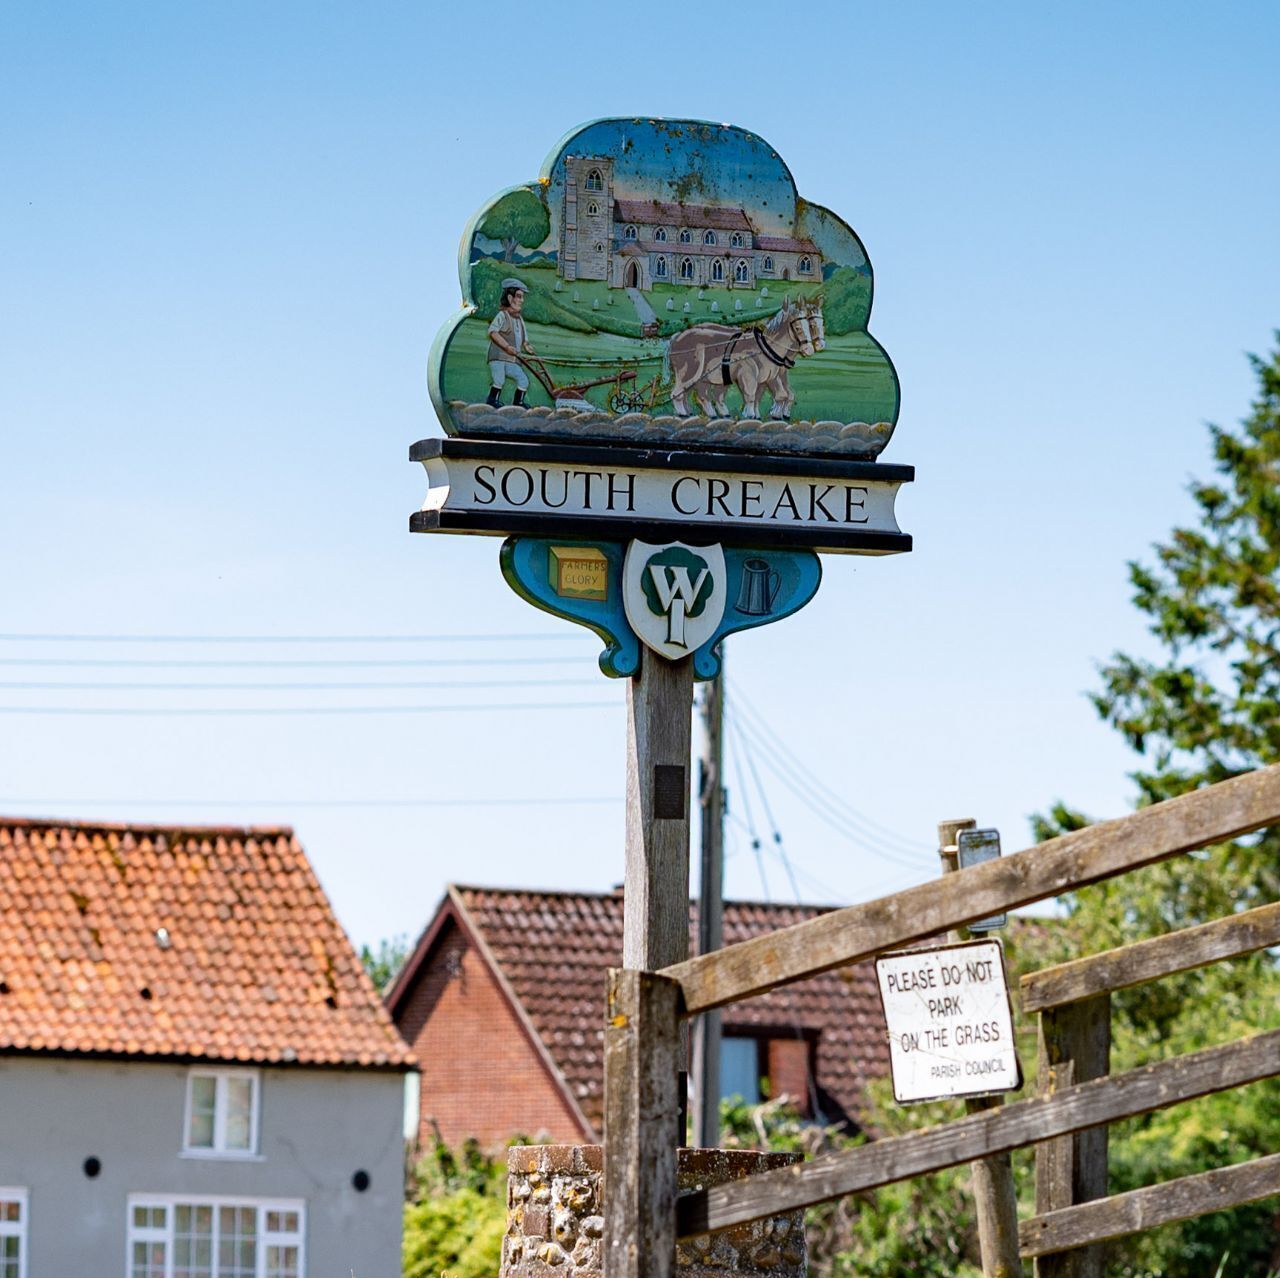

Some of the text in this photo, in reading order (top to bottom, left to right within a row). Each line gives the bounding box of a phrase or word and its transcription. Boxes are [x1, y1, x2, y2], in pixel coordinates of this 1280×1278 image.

[473, 465, 869, 525] SOUTH CREAKE
[561, 561, 606, 572] FARMERS
[565, 575, 598, 585] GLORY
[887, 960, 993, 993] PLEASE DO NOT
[928, 995, 963, 1019] PARK
[901, 1021, 1000, 1053] ON THE GRASS
[931, 1058, 1006, 1079] PARISH COUNCIL
